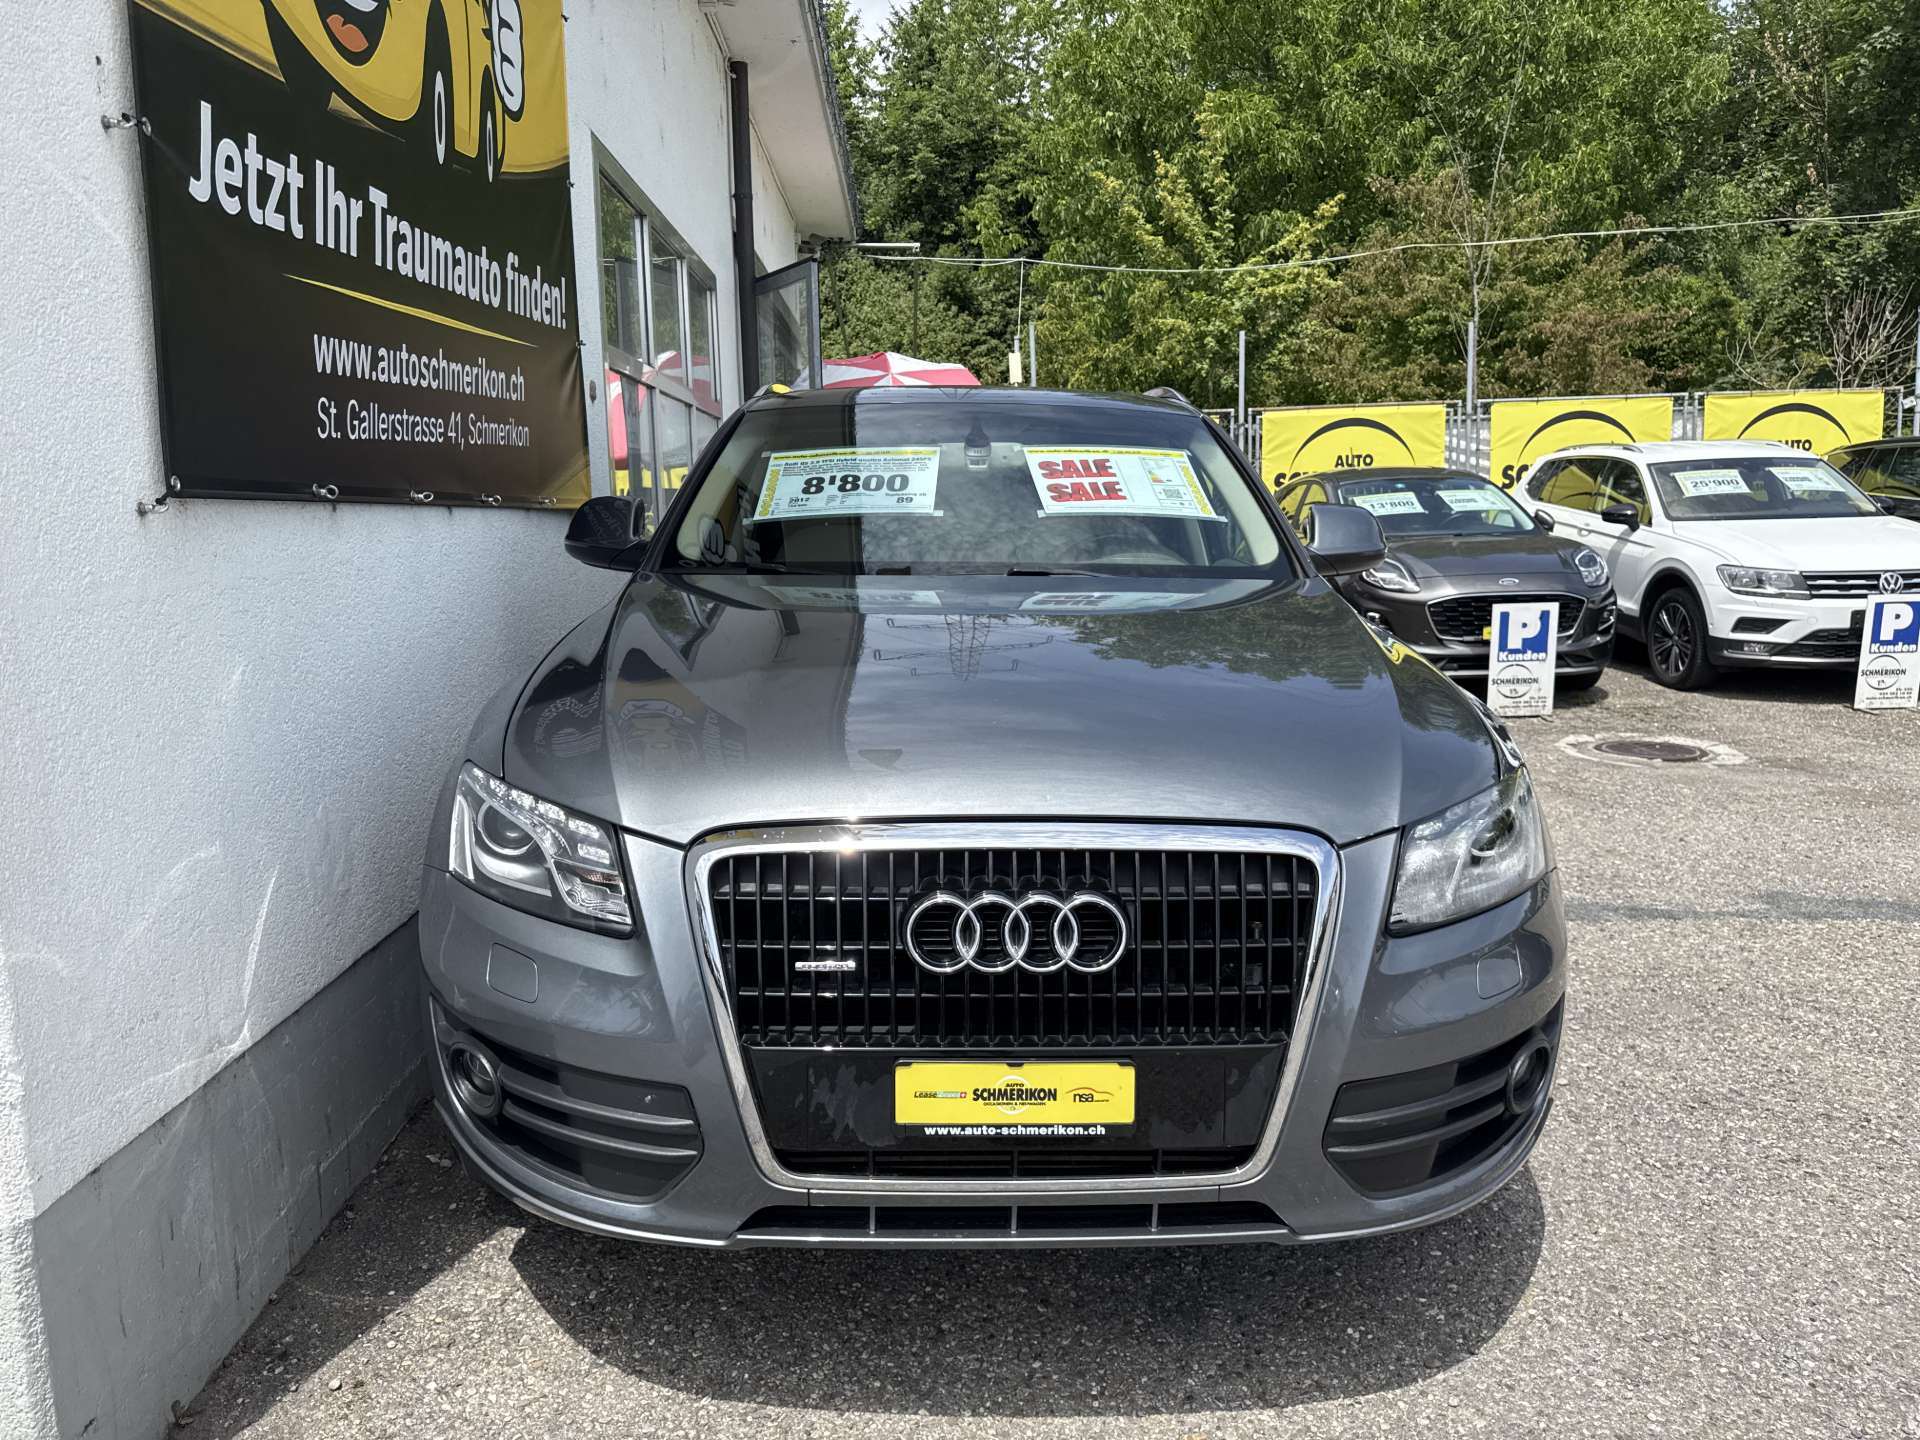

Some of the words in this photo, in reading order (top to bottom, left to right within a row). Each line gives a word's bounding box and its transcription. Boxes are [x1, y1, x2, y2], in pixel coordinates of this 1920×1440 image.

[188, 100, 304, 240] Jetzt
[314, 159, 363, 258] Ihr
[368, 185, 501, 308] Traumauto
[505, 251, 567, 330] finden!
[313, 332, 526, 402] www.autoschmerikon.ch
[317, 397, 342, 439] St.
[346, 398, 445, 444] Gallerstrasse
[447, 411, 465, 451] 41,
[467, 418, 530, 448] Schmerikon
[1334, 454, 1374, 468] AUTO
[1038, 458, 1117, 480] SALE
[801, 473, 910, 495] 8'800
[1046, 481, 1128, 503] SALE
[896, 496, 914, 504] 89
[1880, 602, 1914, 641] P
[1870, 642, 1917, 653] Kunden
[1498, 651, 1547, 662] Kunden
[1860, 668, 1907, 677] SCHMERIKON
[1491, 677, 1539, 686] SCHMERIKON
[972, 1087, 1057, 1102] SCHMERIKON
[1073, 1091, 1094, 1103] nsa
[924, 1125, 1106, 1135] www.auto-schmerikon.ch
